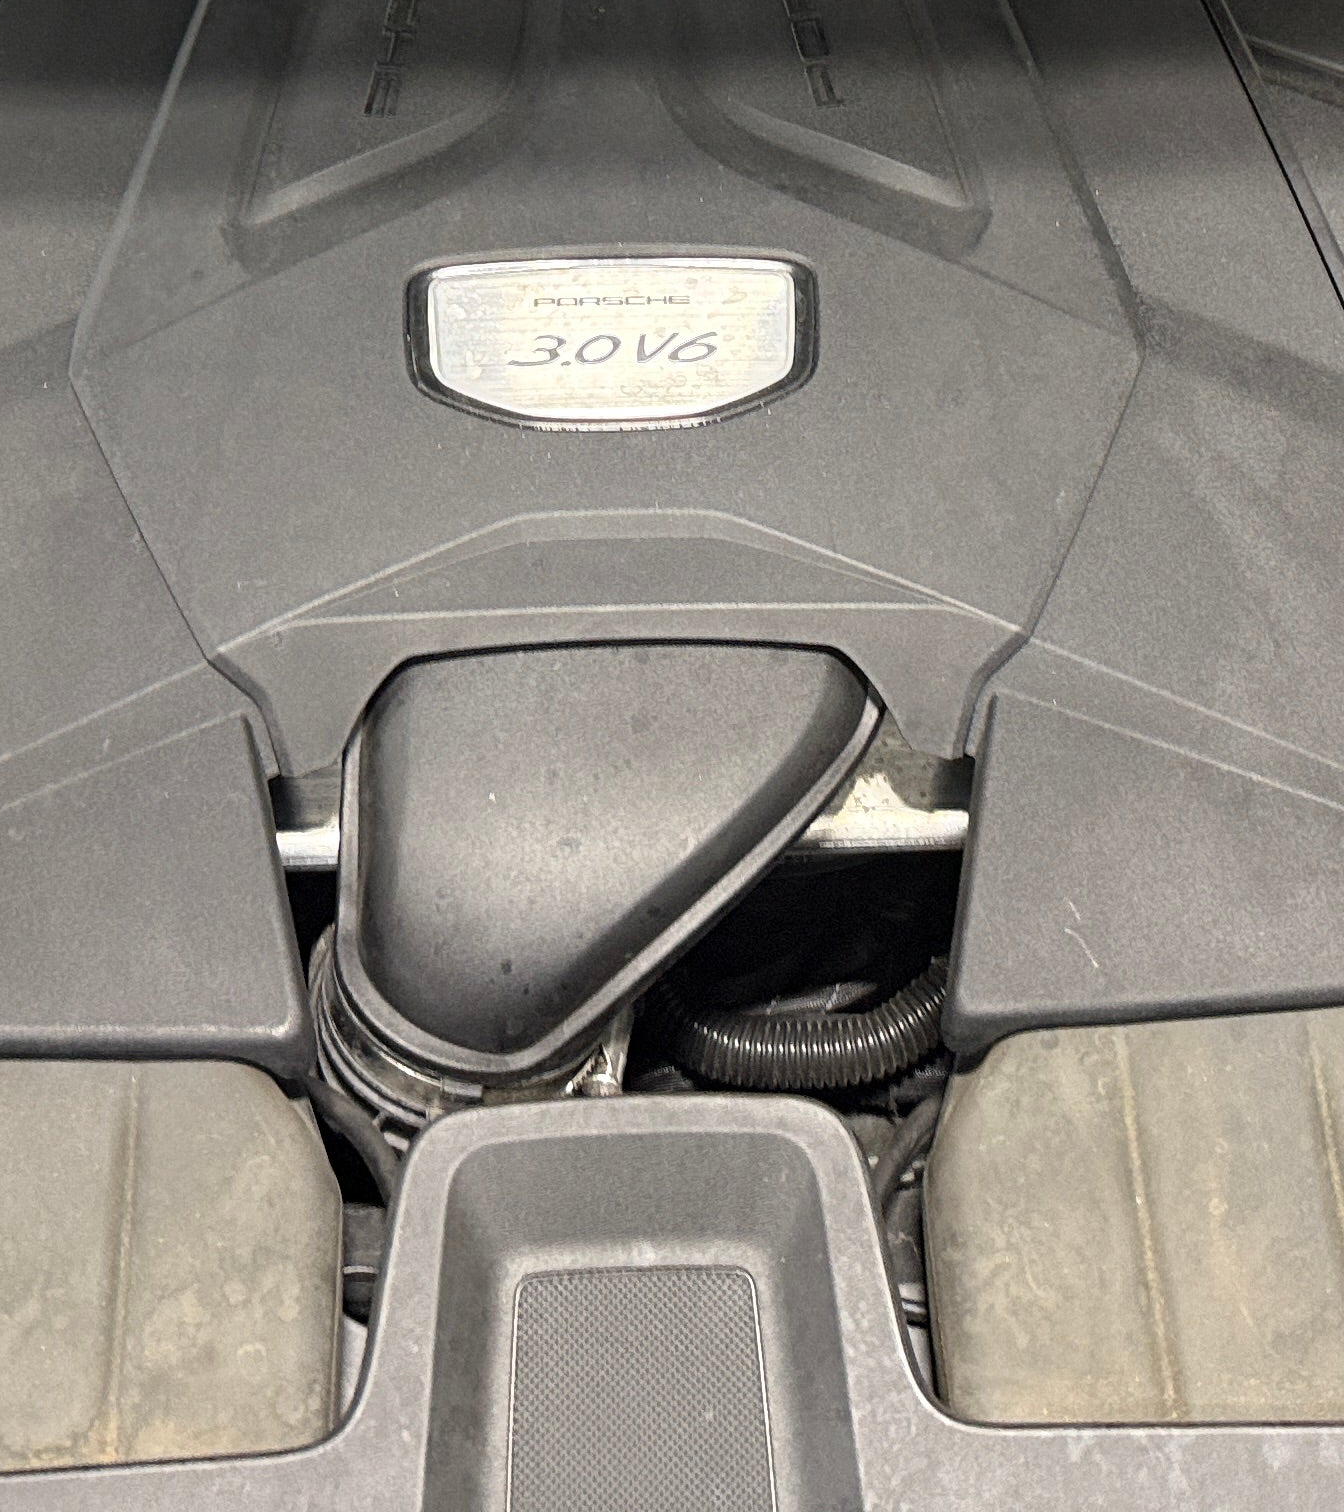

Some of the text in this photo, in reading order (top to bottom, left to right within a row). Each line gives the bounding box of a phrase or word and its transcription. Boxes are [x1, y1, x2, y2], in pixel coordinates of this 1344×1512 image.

[533, 295, 691, 308] PORSCHE
[507, 331, 719, 367] 3.0 V6
